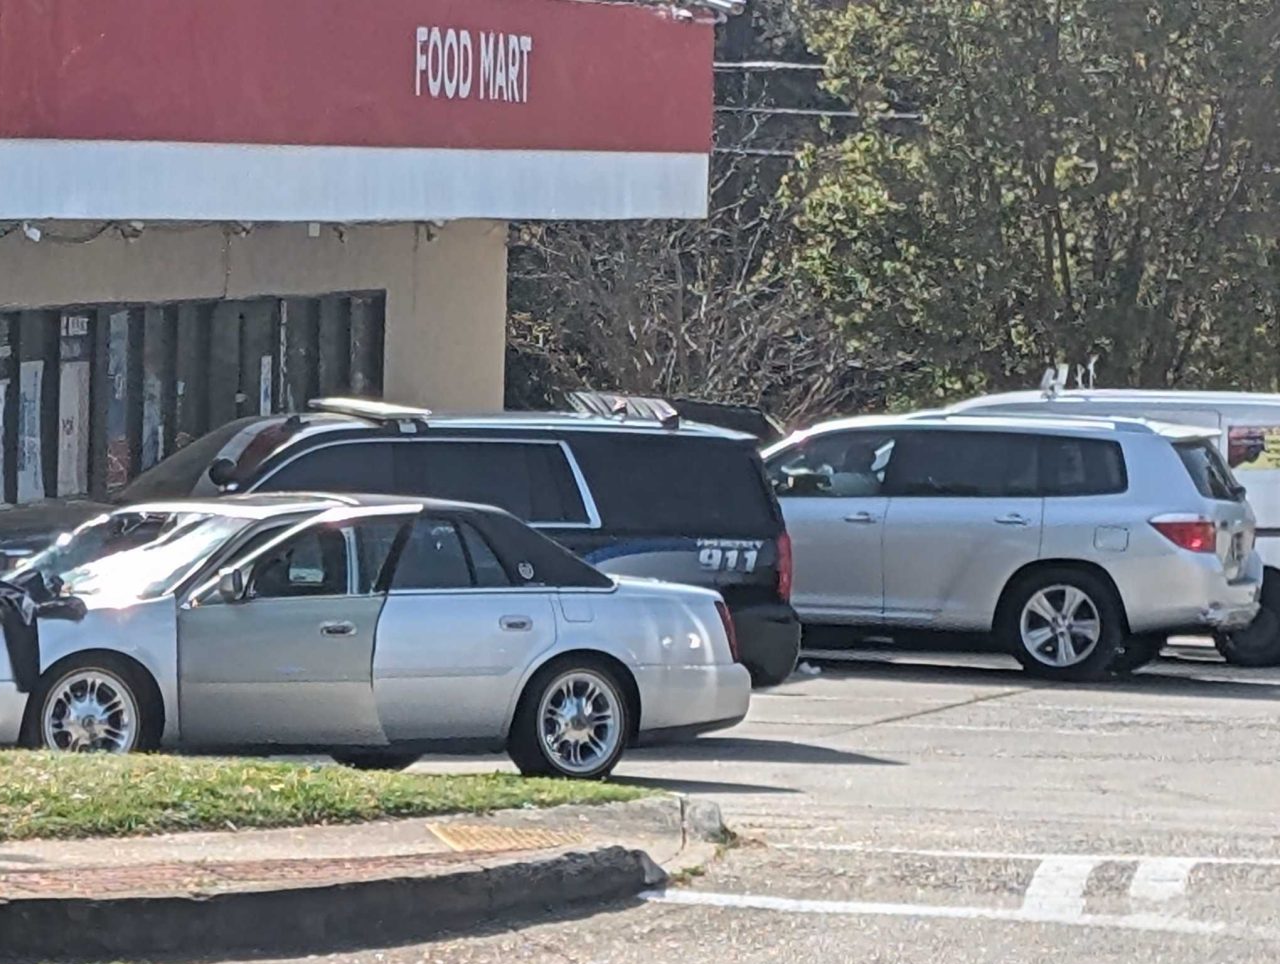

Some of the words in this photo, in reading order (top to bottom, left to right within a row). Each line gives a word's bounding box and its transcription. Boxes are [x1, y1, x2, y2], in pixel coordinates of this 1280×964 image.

[415, 26, 472, 99] FOOD
[479, 29, 532, 103] MART
[699, 548, 758, 573] 911
